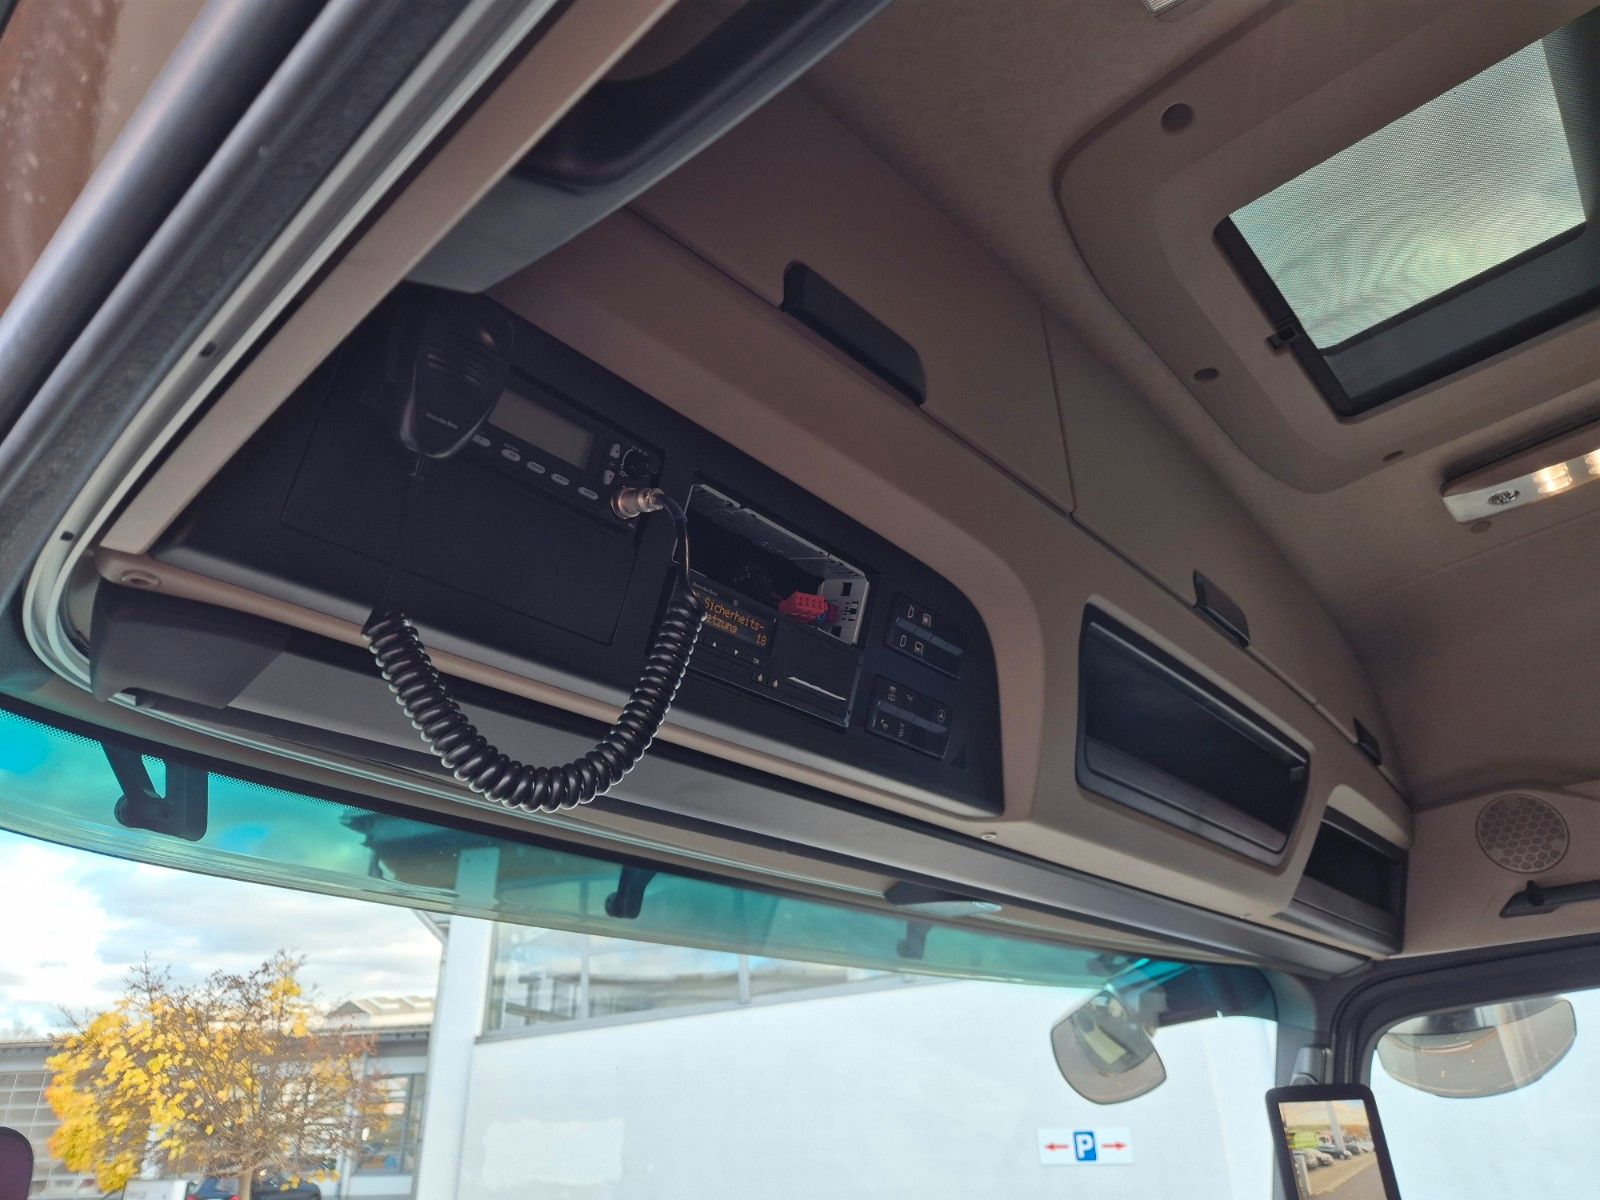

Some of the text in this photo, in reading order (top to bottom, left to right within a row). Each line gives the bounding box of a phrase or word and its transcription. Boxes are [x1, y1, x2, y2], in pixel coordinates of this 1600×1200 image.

[704, 597, 765, 631] Sicherheits-
[706, 613, 768, 647] etzung 18
[1074, 1133, 1095, 1160] P
